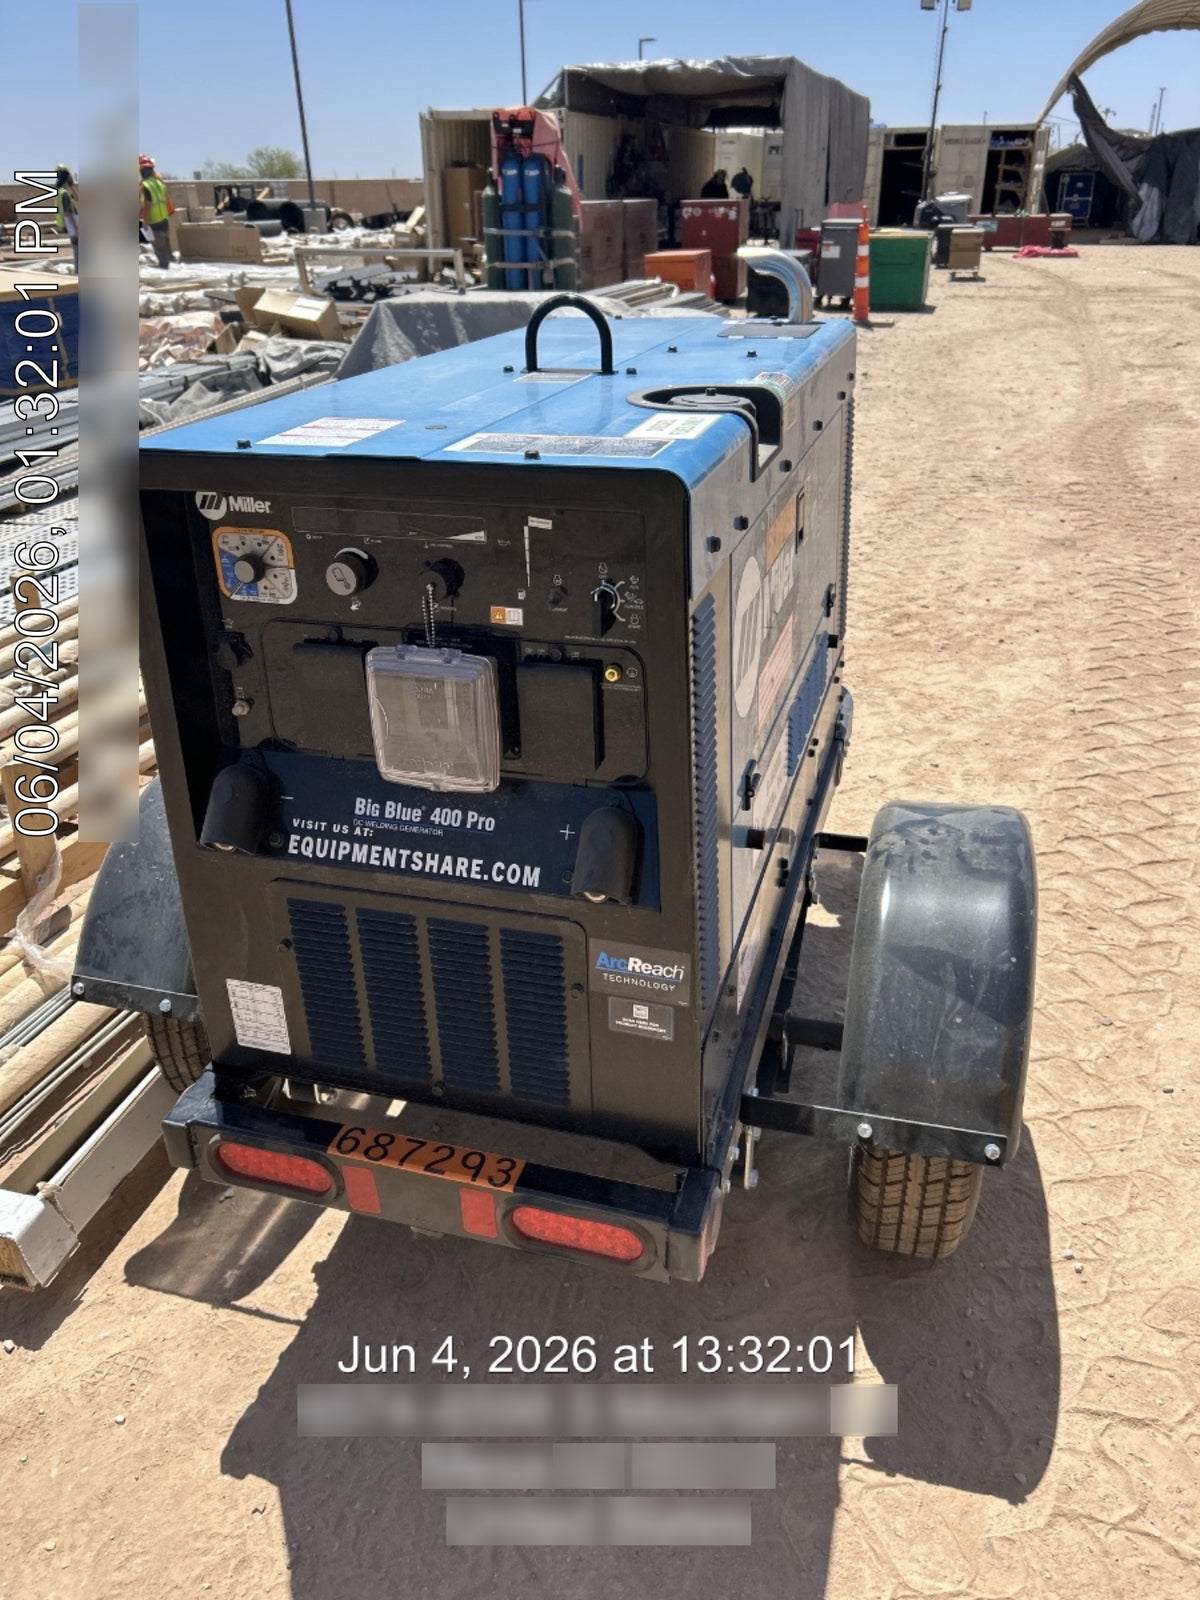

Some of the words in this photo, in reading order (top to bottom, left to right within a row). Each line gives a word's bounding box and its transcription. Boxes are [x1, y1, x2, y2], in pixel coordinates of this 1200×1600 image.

[229, 494, 272, 514] Miller
[354, 797, 380, 818] Big
[430, 807, 462, 828] 400
[466, 810, 496, 832] Pro
[292, 818, 327, 832] VISIT
[332, 823, 350, 835] US
[353, 826, 374, 838] AT:
[364, 820, 398, 832] WELDING
[399, 824, 444, 837] GENERATOR
[288, 834, 541, 887] EQUIPMENTSHARE.COM
[595, 951, 685, 981] ArcReach
[602, 972, 676, 992] TECHNOLOGY
[336, 1126, 518, 1189] 687293
